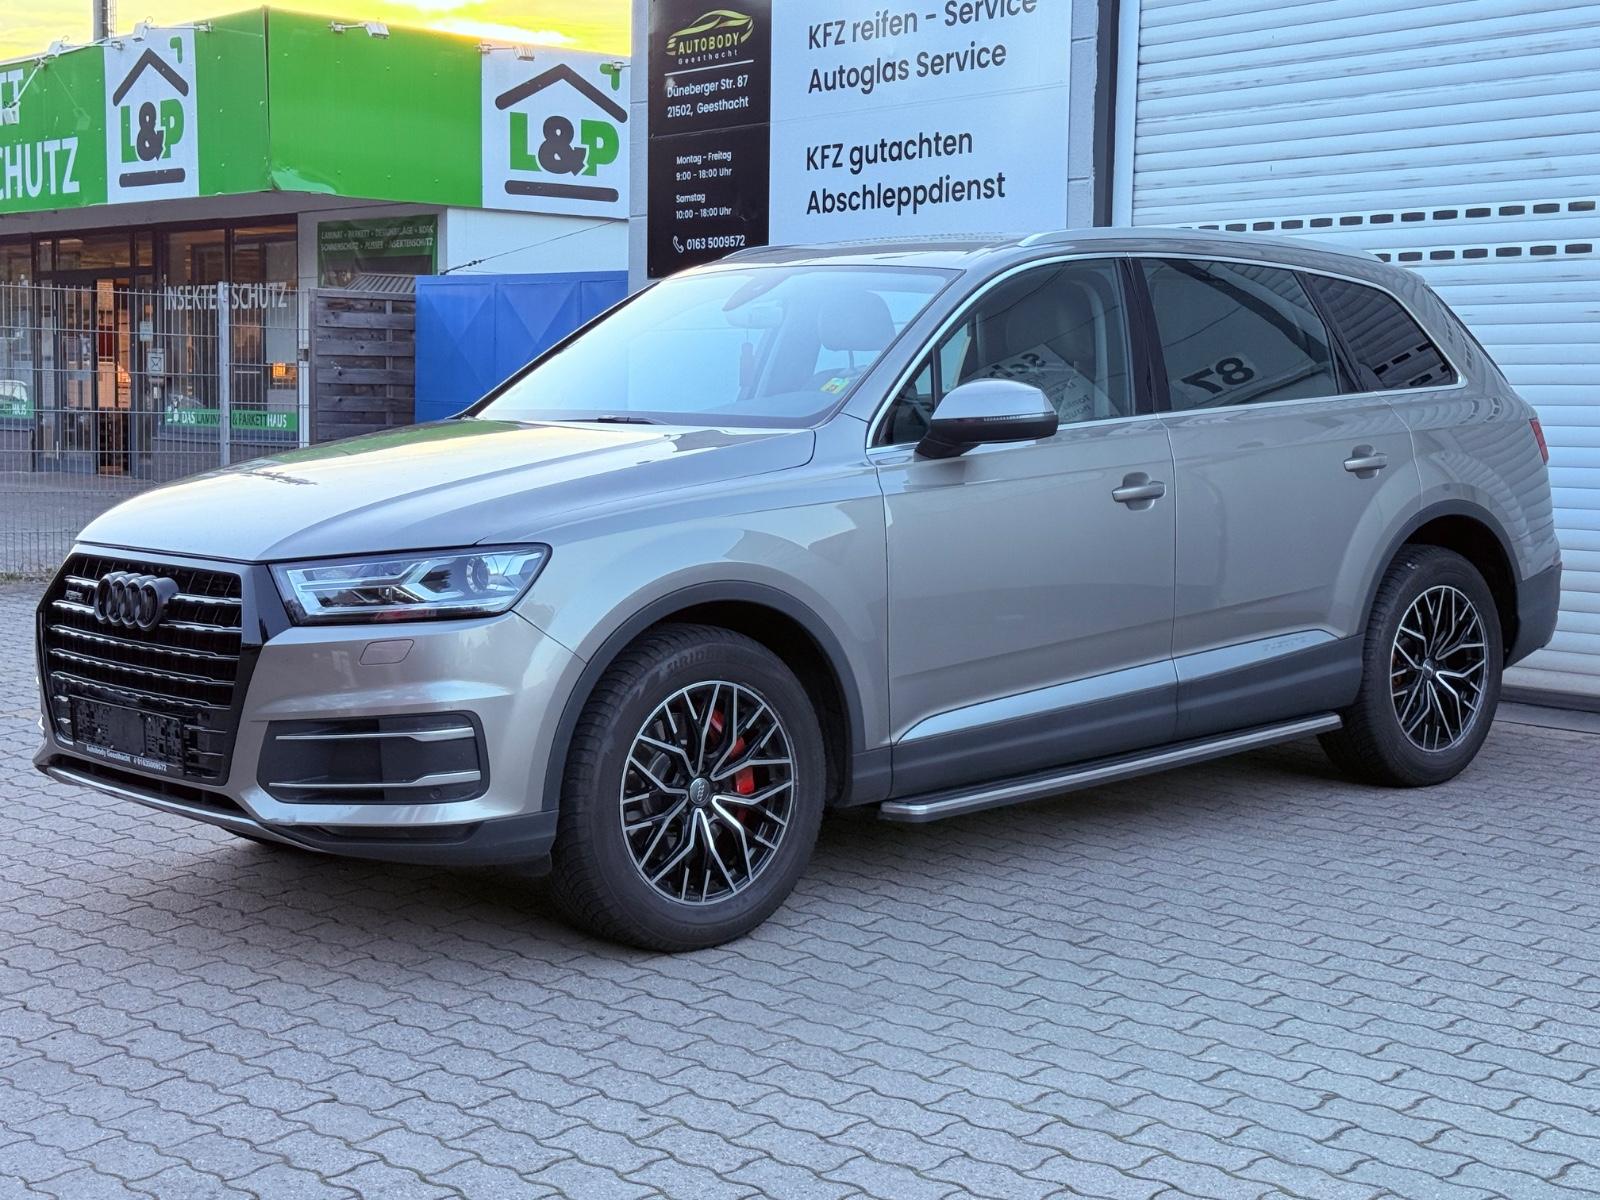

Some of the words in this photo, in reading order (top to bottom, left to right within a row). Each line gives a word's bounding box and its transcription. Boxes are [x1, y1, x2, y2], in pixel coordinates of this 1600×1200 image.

[808, 20, 846, 50] KFZ
[852, 9, 918, 43] reifen
[944, 0, 1038, 27] Service
[678, 32, 740, 55] AUTOBODY
[678, 49, 738, 65] Geesthacht
[808, 57, 910, 95] Autoglas
[916, 41, 1007, 78] Service
[667, 81, 719, 98] Düneberger
[721, 78, 736, 90] Str.
[737, 75, 749, 87] 87
[667, 104, 694, 118] 21502,
[697, 96, 749, 114] Geesthacht
[120, 99, 185, 163] L&P
[509, 111, 620, 177] L&P
[806, 143, 844, 171] KFZ
[849, 131, 973, 175] gutachten
[676, 155, 702, 165] Montag
[708, 151, 732, 161] Freitag
[676, 171, 692, 181] 9:00
[699, 168, 717, 179] 18:00
[719, 167, 732, 176] Uhr
[676, 193, 706, 203] Samstag
[806, 172, 1006, 216] Abschleppdienst
[676, 209, 694, 219] 10:00
[700, 207, 718, 217] 18:00
[719, 206, 732, 216] Uhr
[686, 237, 706, 250] 0163
[708, 235, 746, 248] 5009572
[164, 281, 288, 311] INSEKTESCHUTZ
